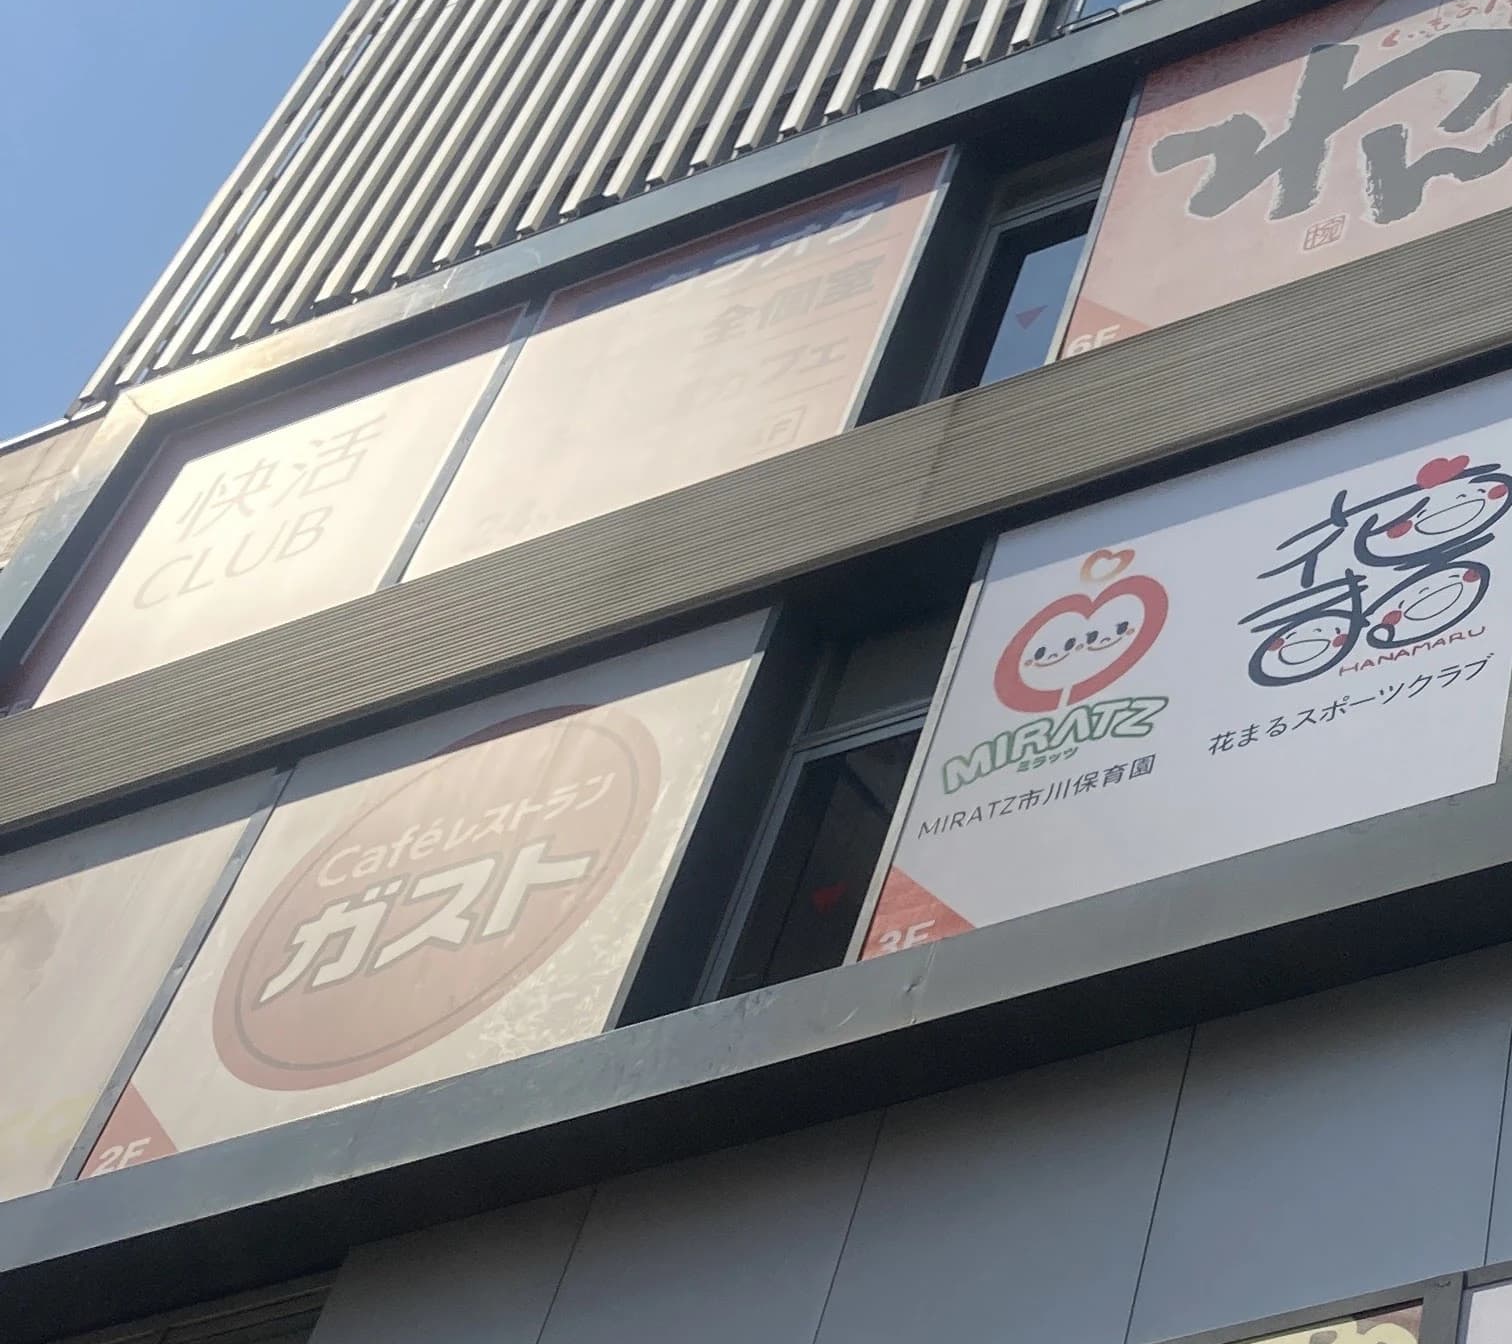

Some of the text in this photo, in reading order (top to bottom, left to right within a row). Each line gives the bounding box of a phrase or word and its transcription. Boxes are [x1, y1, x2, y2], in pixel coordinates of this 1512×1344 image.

[133, 506, 338, 610] CLUB
[1338, 624, 1488, 677] HANAMARU
[941, 695, 1169, 795] MIRATZ
[1207, 652, 1496, 757] 花まるスポーツクラブ
[917, 753, 1157, 839] MIRATZ市川保育園
[251, 836, 598, 1014] ガスト
[98, 1137, 152, 1176] 2F
